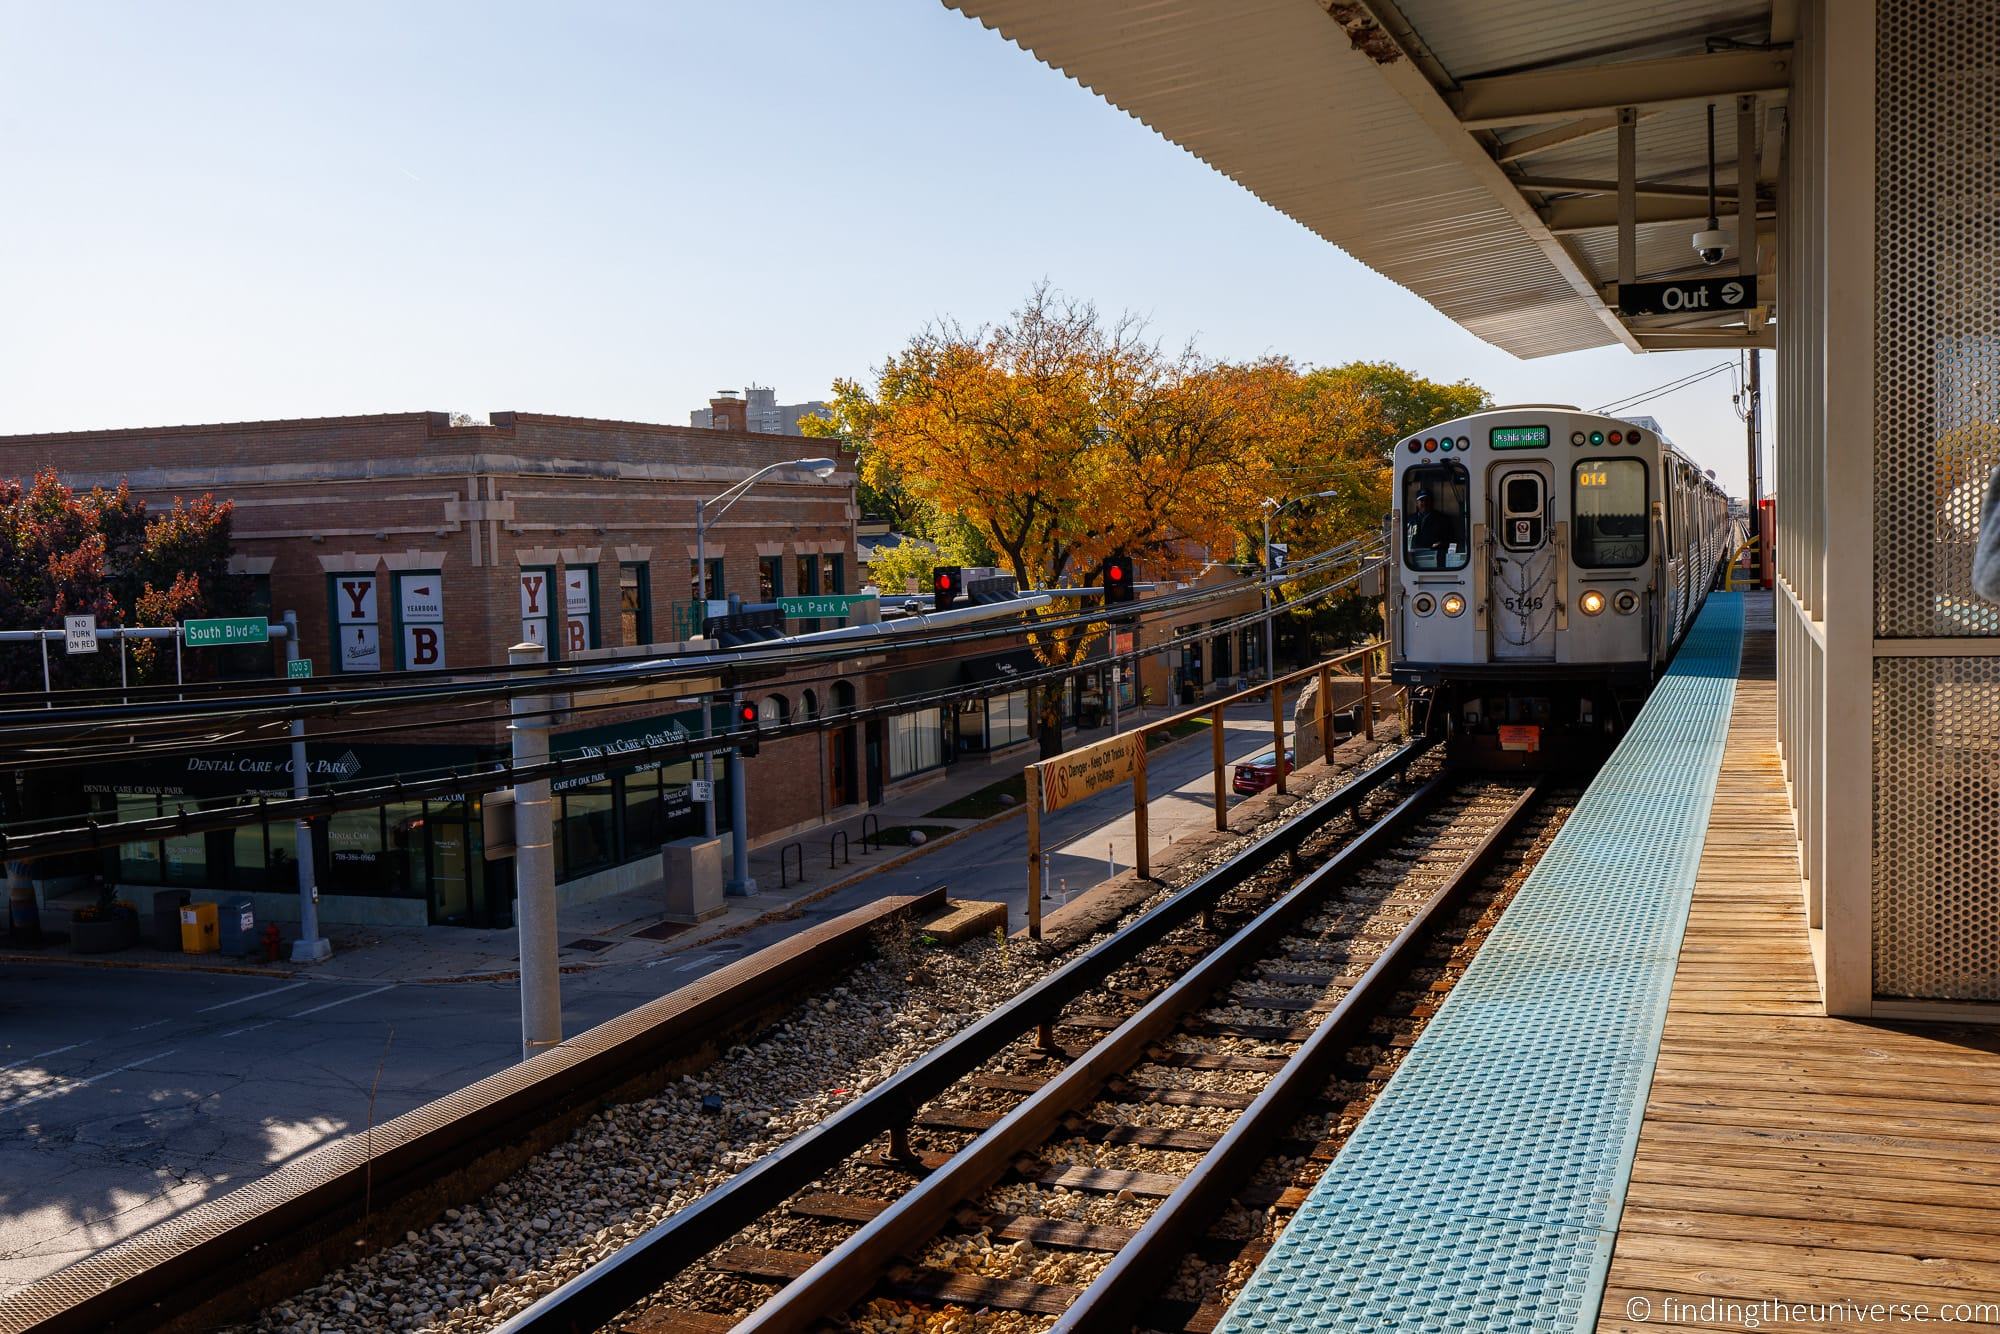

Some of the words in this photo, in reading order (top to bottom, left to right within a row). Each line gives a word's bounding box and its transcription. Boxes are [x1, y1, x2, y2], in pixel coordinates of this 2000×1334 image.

[1662, 285, 1709, 310] Out
[1580, 472, 1607, 487] 014
[342, 582, 371, 618] Y
[522, 576, 543, 613] Y
[407, 604, 438, 612] YEARBOOK
[782, 602, 803, 614] Oak
[808, 601, 835, 613] Park
[1505, 596, 1543, 610] 5146
[74, 620, 87, 628] NO
[72, 629, 91, 639] TURN
[190, 626, 222, 640] South
[226, 624, 249, 638] Blvd
[568, 621, 585, 651] B
[69, 640, 79, 649] ON
[81, 640, 96, 649] RED
[412, 628, 438, 664] B
[580, 746, 617, 758] DENAL
[187, 758, 236, 771] DENTAL
[240, 758, 273, 772] CARE
[317, 760, 349, 773] PARK
[1068, 762, 1088, 778] Danger
[1091, 756, 1103, 769] Keep
[1103, 750, 1111, 764] Off
[1110, 747, 1124, 761] Tracks
[553, 781, 569, 791] CARE
[569, 779, 577, 788] OF
[578, 775, 590, 786] OAK
[591, 772, 606, 783] PARK
[1086, 774, 1097, 790] High
[1097, 768, 1114, 783] Voltage
[83, 785, 111, 793] DENTAL
[146, 786, 162, 794] OAK
[164, 787, 184, 795] PARK
